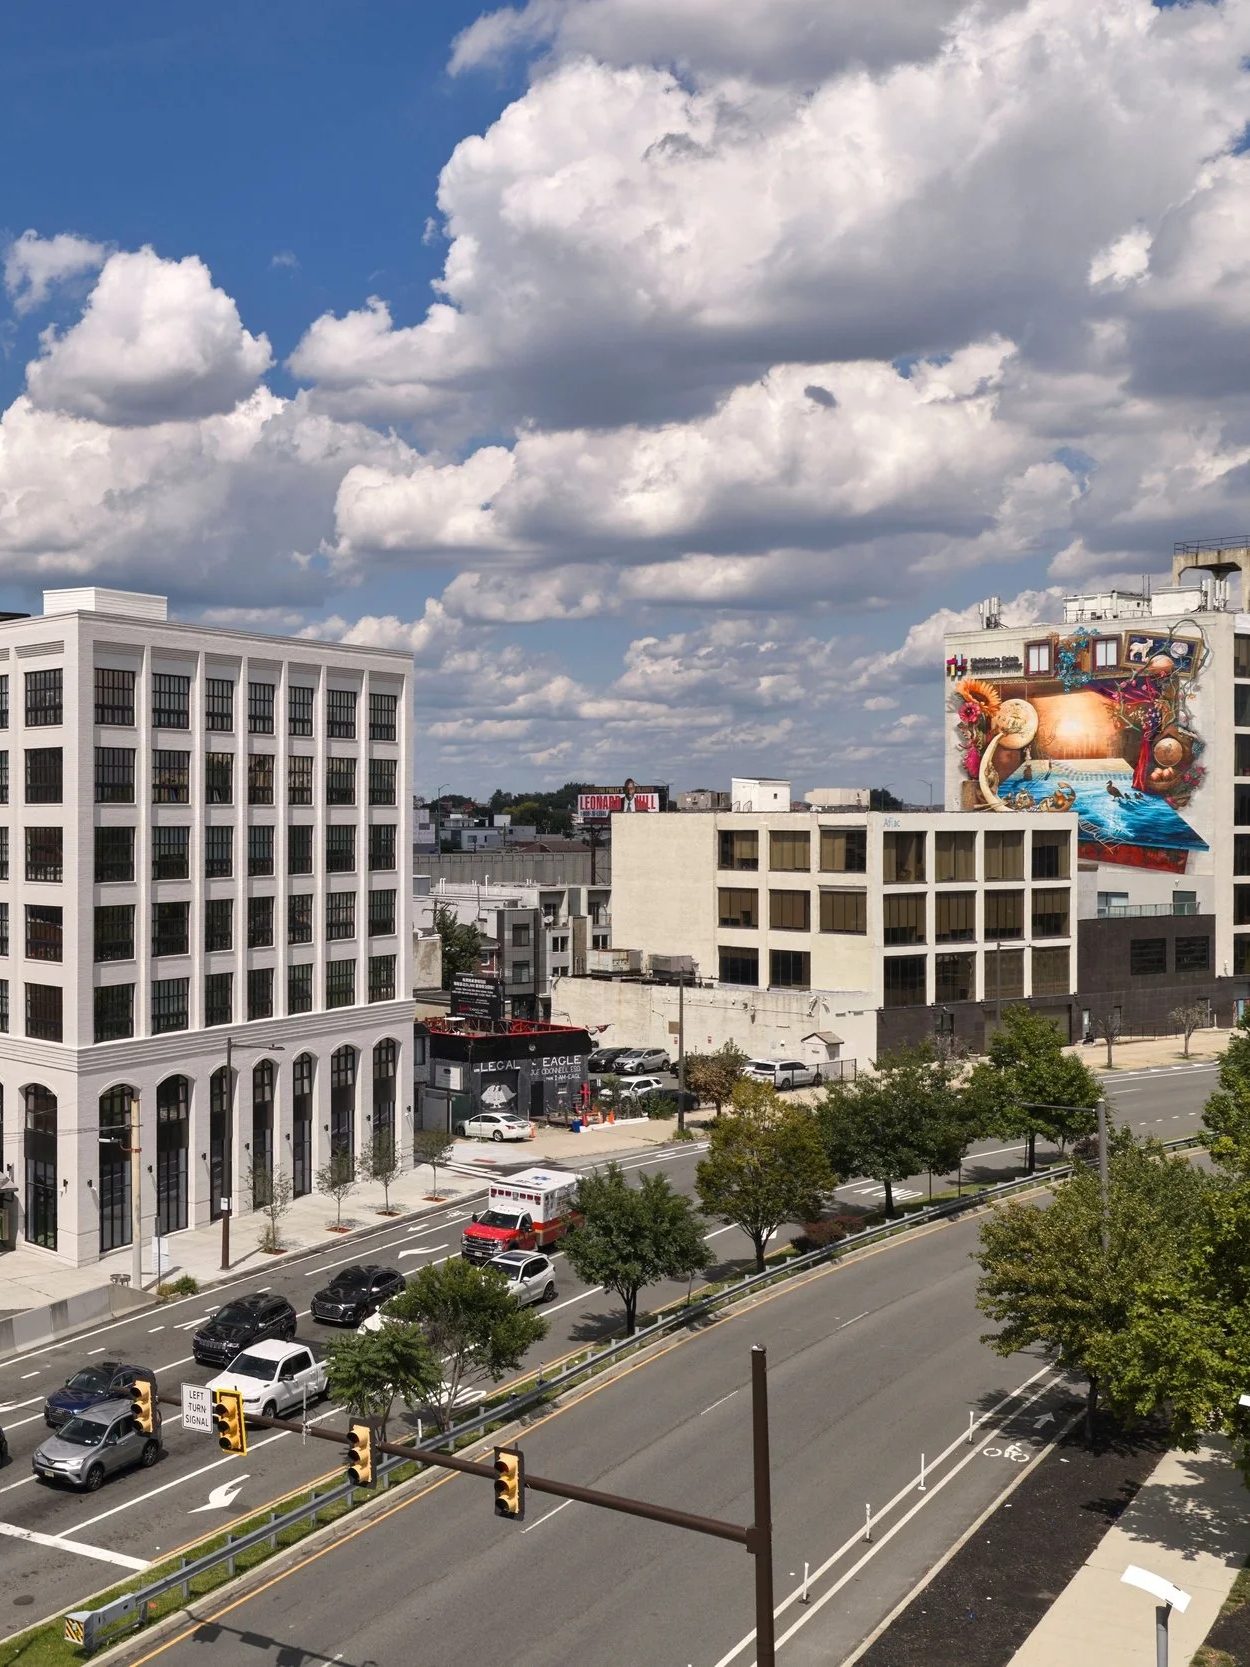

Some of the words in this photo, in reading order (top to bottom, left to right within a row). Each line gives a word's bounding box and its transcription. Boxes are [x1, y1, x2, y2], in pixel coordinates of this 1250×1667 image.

[579, 795, 622, 810] LEONARD
[635, 795, 656, 810] HILL
[481, 1060, 521, 1072] LEGAL
[542, 1054, 582, 1067] EAGLE
[189, 1390, 204, 1400] LEFT
[188, 1402, 206, 1414] TURN
[185, 1414, 209, 1427] SIGNAL
